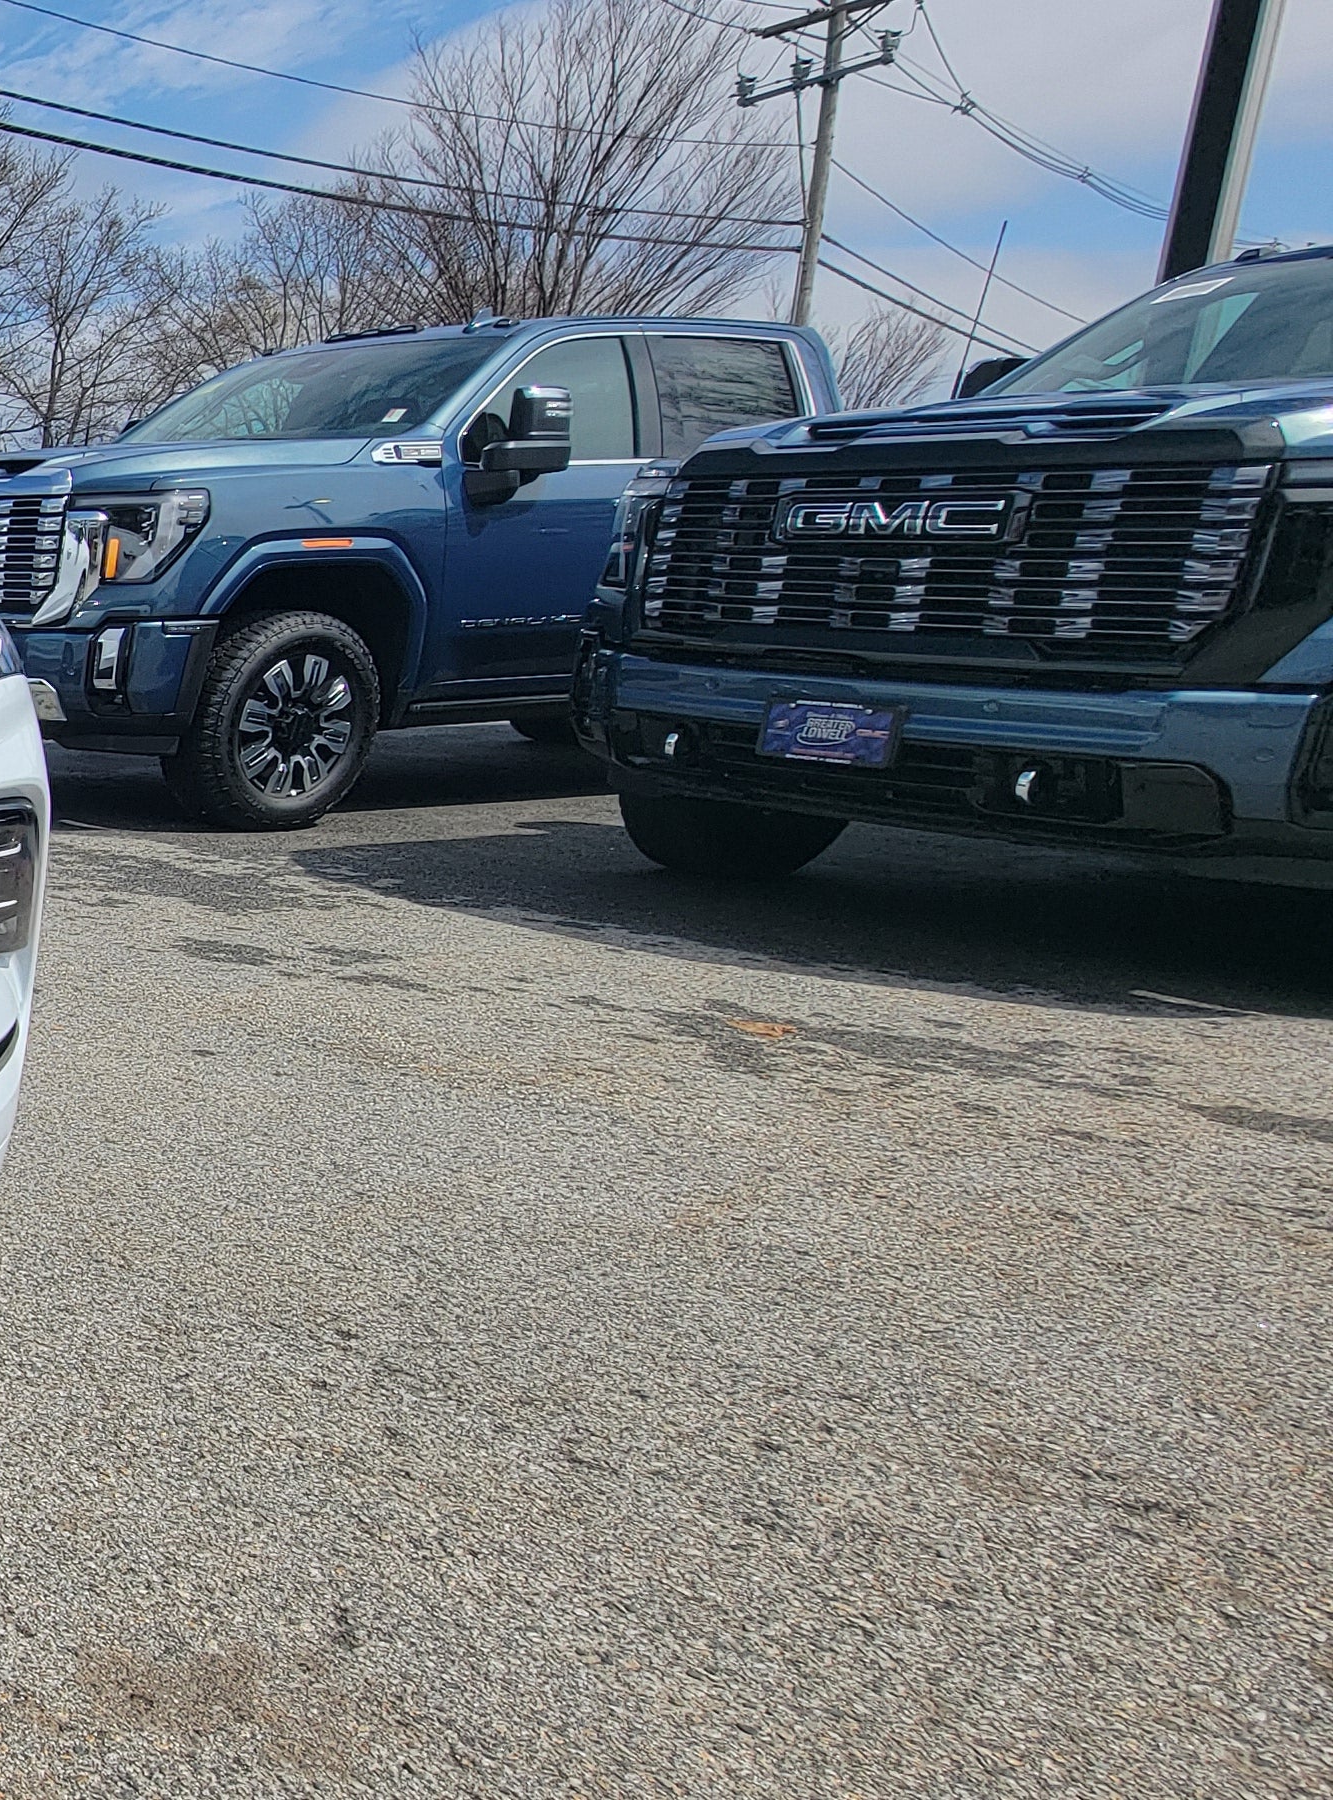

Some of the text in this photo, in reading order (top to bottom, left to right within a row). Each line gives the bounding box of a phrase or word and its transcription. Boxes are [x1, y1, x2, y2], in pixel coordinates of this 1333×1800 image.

[787, 500, 1005, 535] GMC
[806, 717, 855, 732] GREATER
[801, 727, 848, 741] LOWELL
